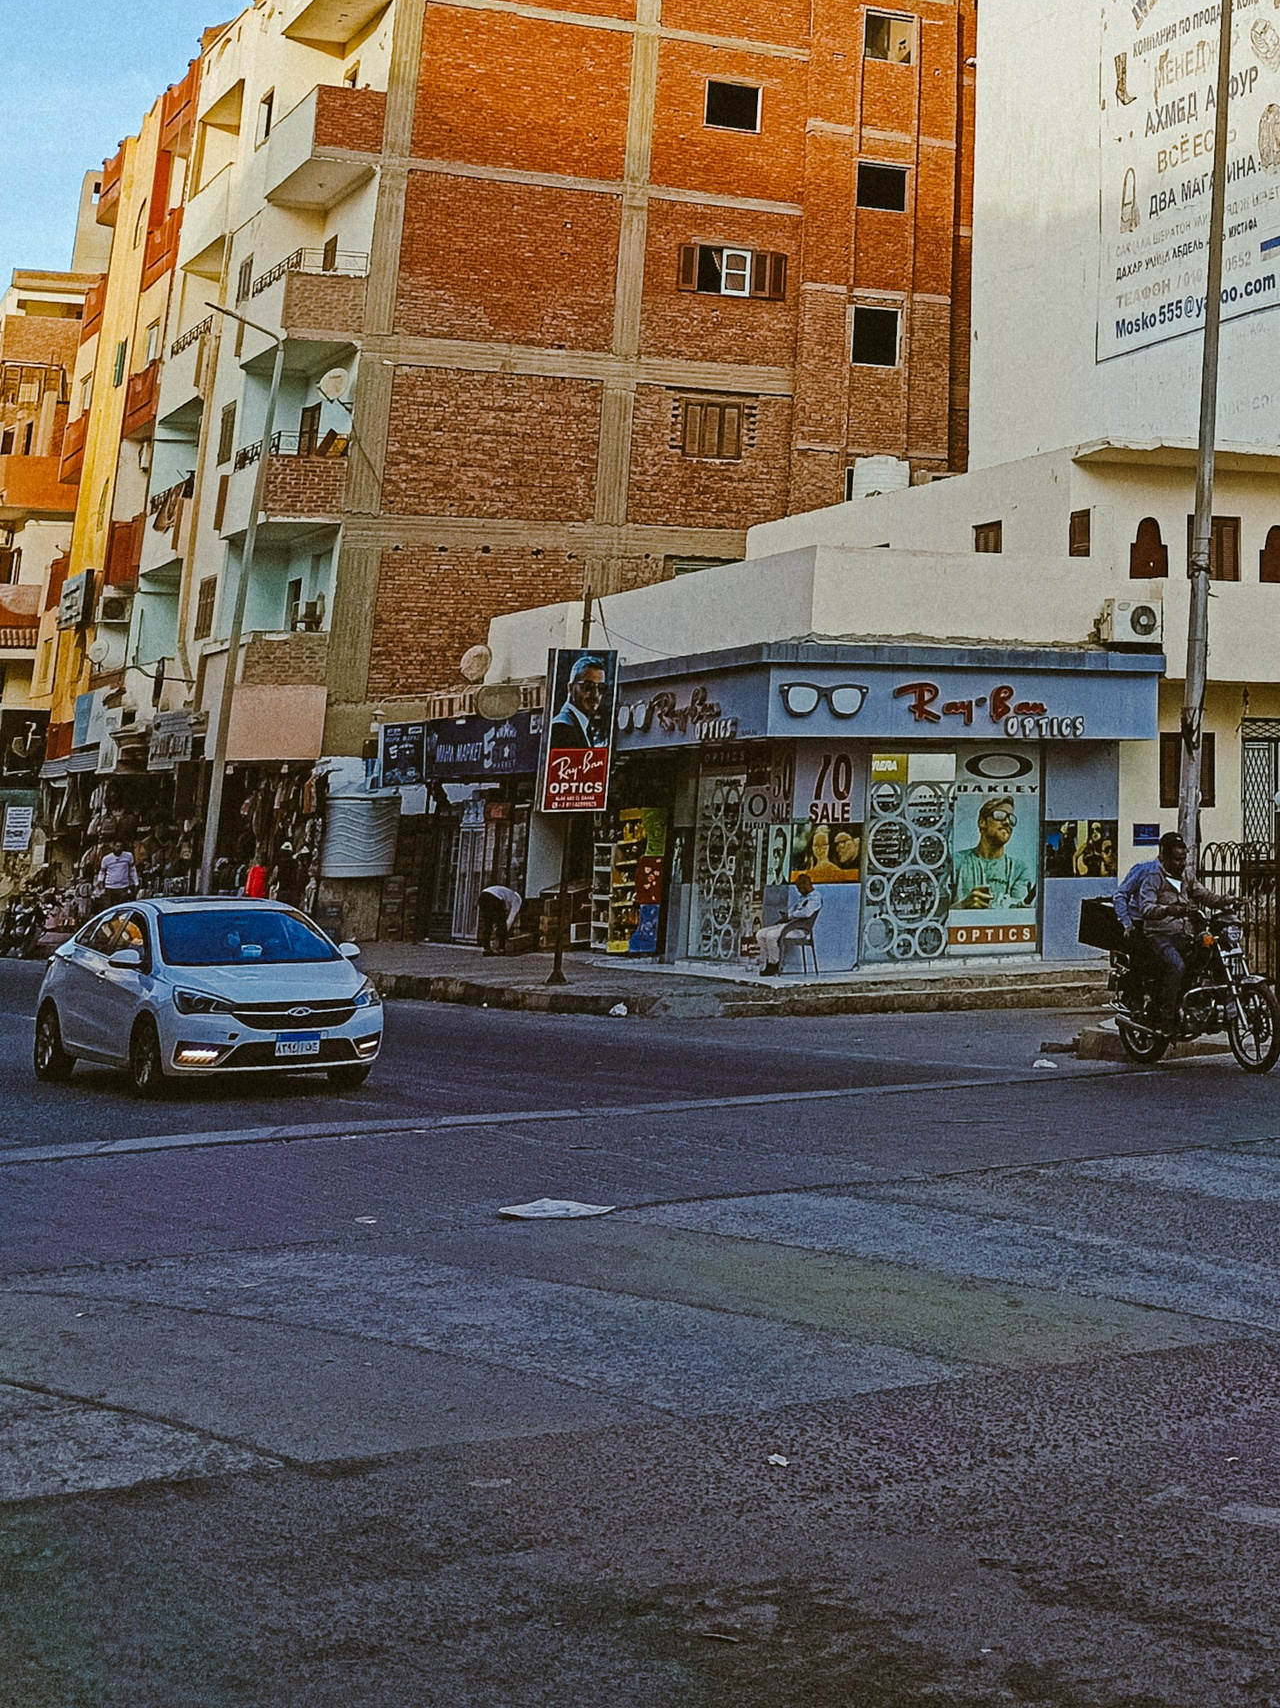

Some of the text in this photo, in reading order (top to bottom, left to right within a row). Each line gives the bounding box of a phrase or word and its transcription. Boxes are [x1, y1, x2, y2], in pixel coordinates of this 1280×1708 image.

[1192, 1, 1235, 31] ПРОДАЕ
[1149, 154, 1262, 220] ДВА МАГАИНА:
[1115, 272, 1276, 339] Mosko555@yaoo.com
[694, 716, 738, 740] OPTICS
[1004, 715, 1085, 738] OPTICS
[549, 781, 603, 794] OPTICS
[813, 753, 853, 801] 70
[957, 785, 1039, 793] OAKLEY
[809, 802, 851, 823] SALE
[957, 927, 1031, 943] OPTICS
